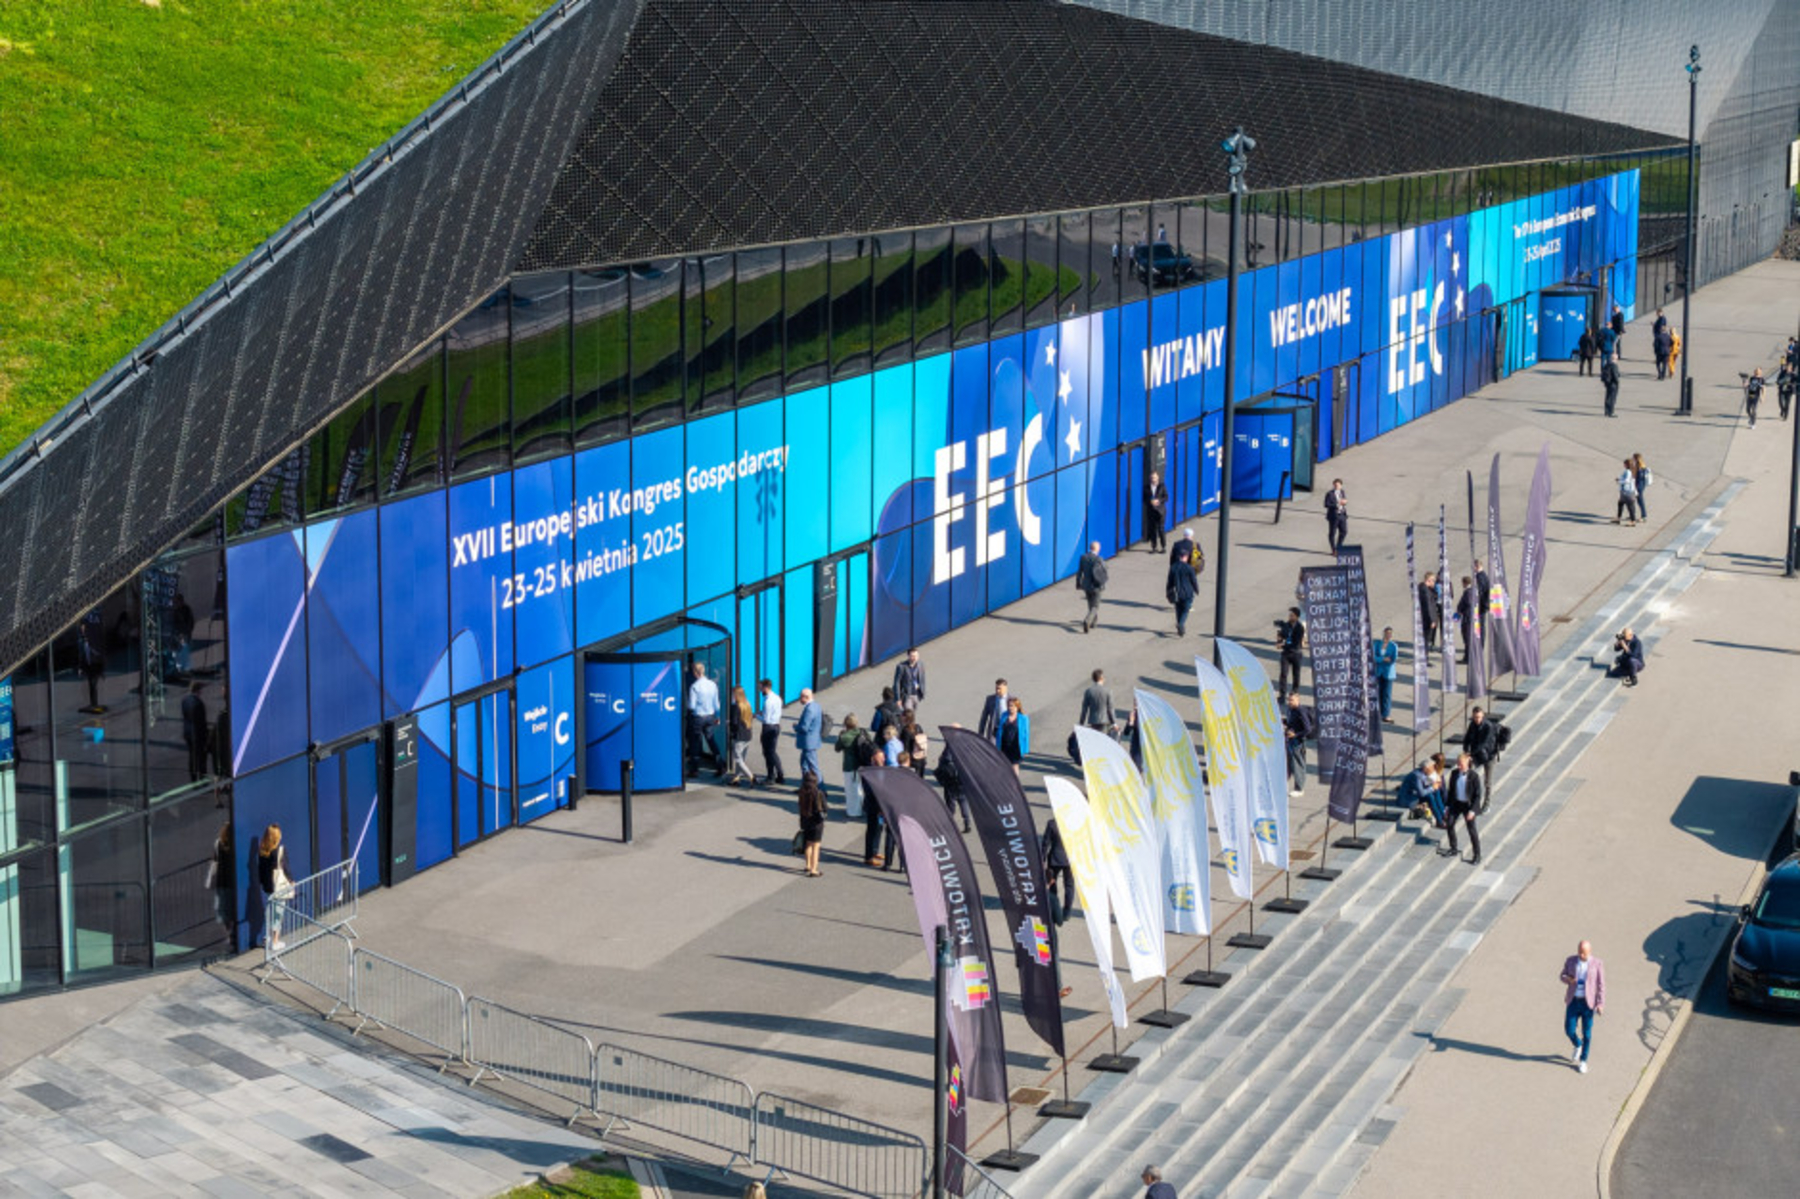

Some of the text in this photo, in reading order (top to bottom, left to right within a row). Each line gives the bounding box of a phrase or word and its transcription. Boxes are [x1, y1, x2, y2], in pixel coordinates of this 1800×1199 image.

[1141, 326, 1226, 390] WITAMY
[1269, 286, 1352, 348] WELCOME
[1387, 280, 1445, 394] EEC
[452, 444, 790, 567] XVII Europejski Kongres Gospodarczy
[933, 412, 1043, 585] EEC
[501, 522, 685, 609] 23-25 kwietnia 2025
[555, 711, 570, 746] C
[612, 698, 625, 714] C
[664, 696, 676, 712] C
[929, 833, 974, 946] KATOWICE
[997, 802, 1038, 906] KATOWICE
